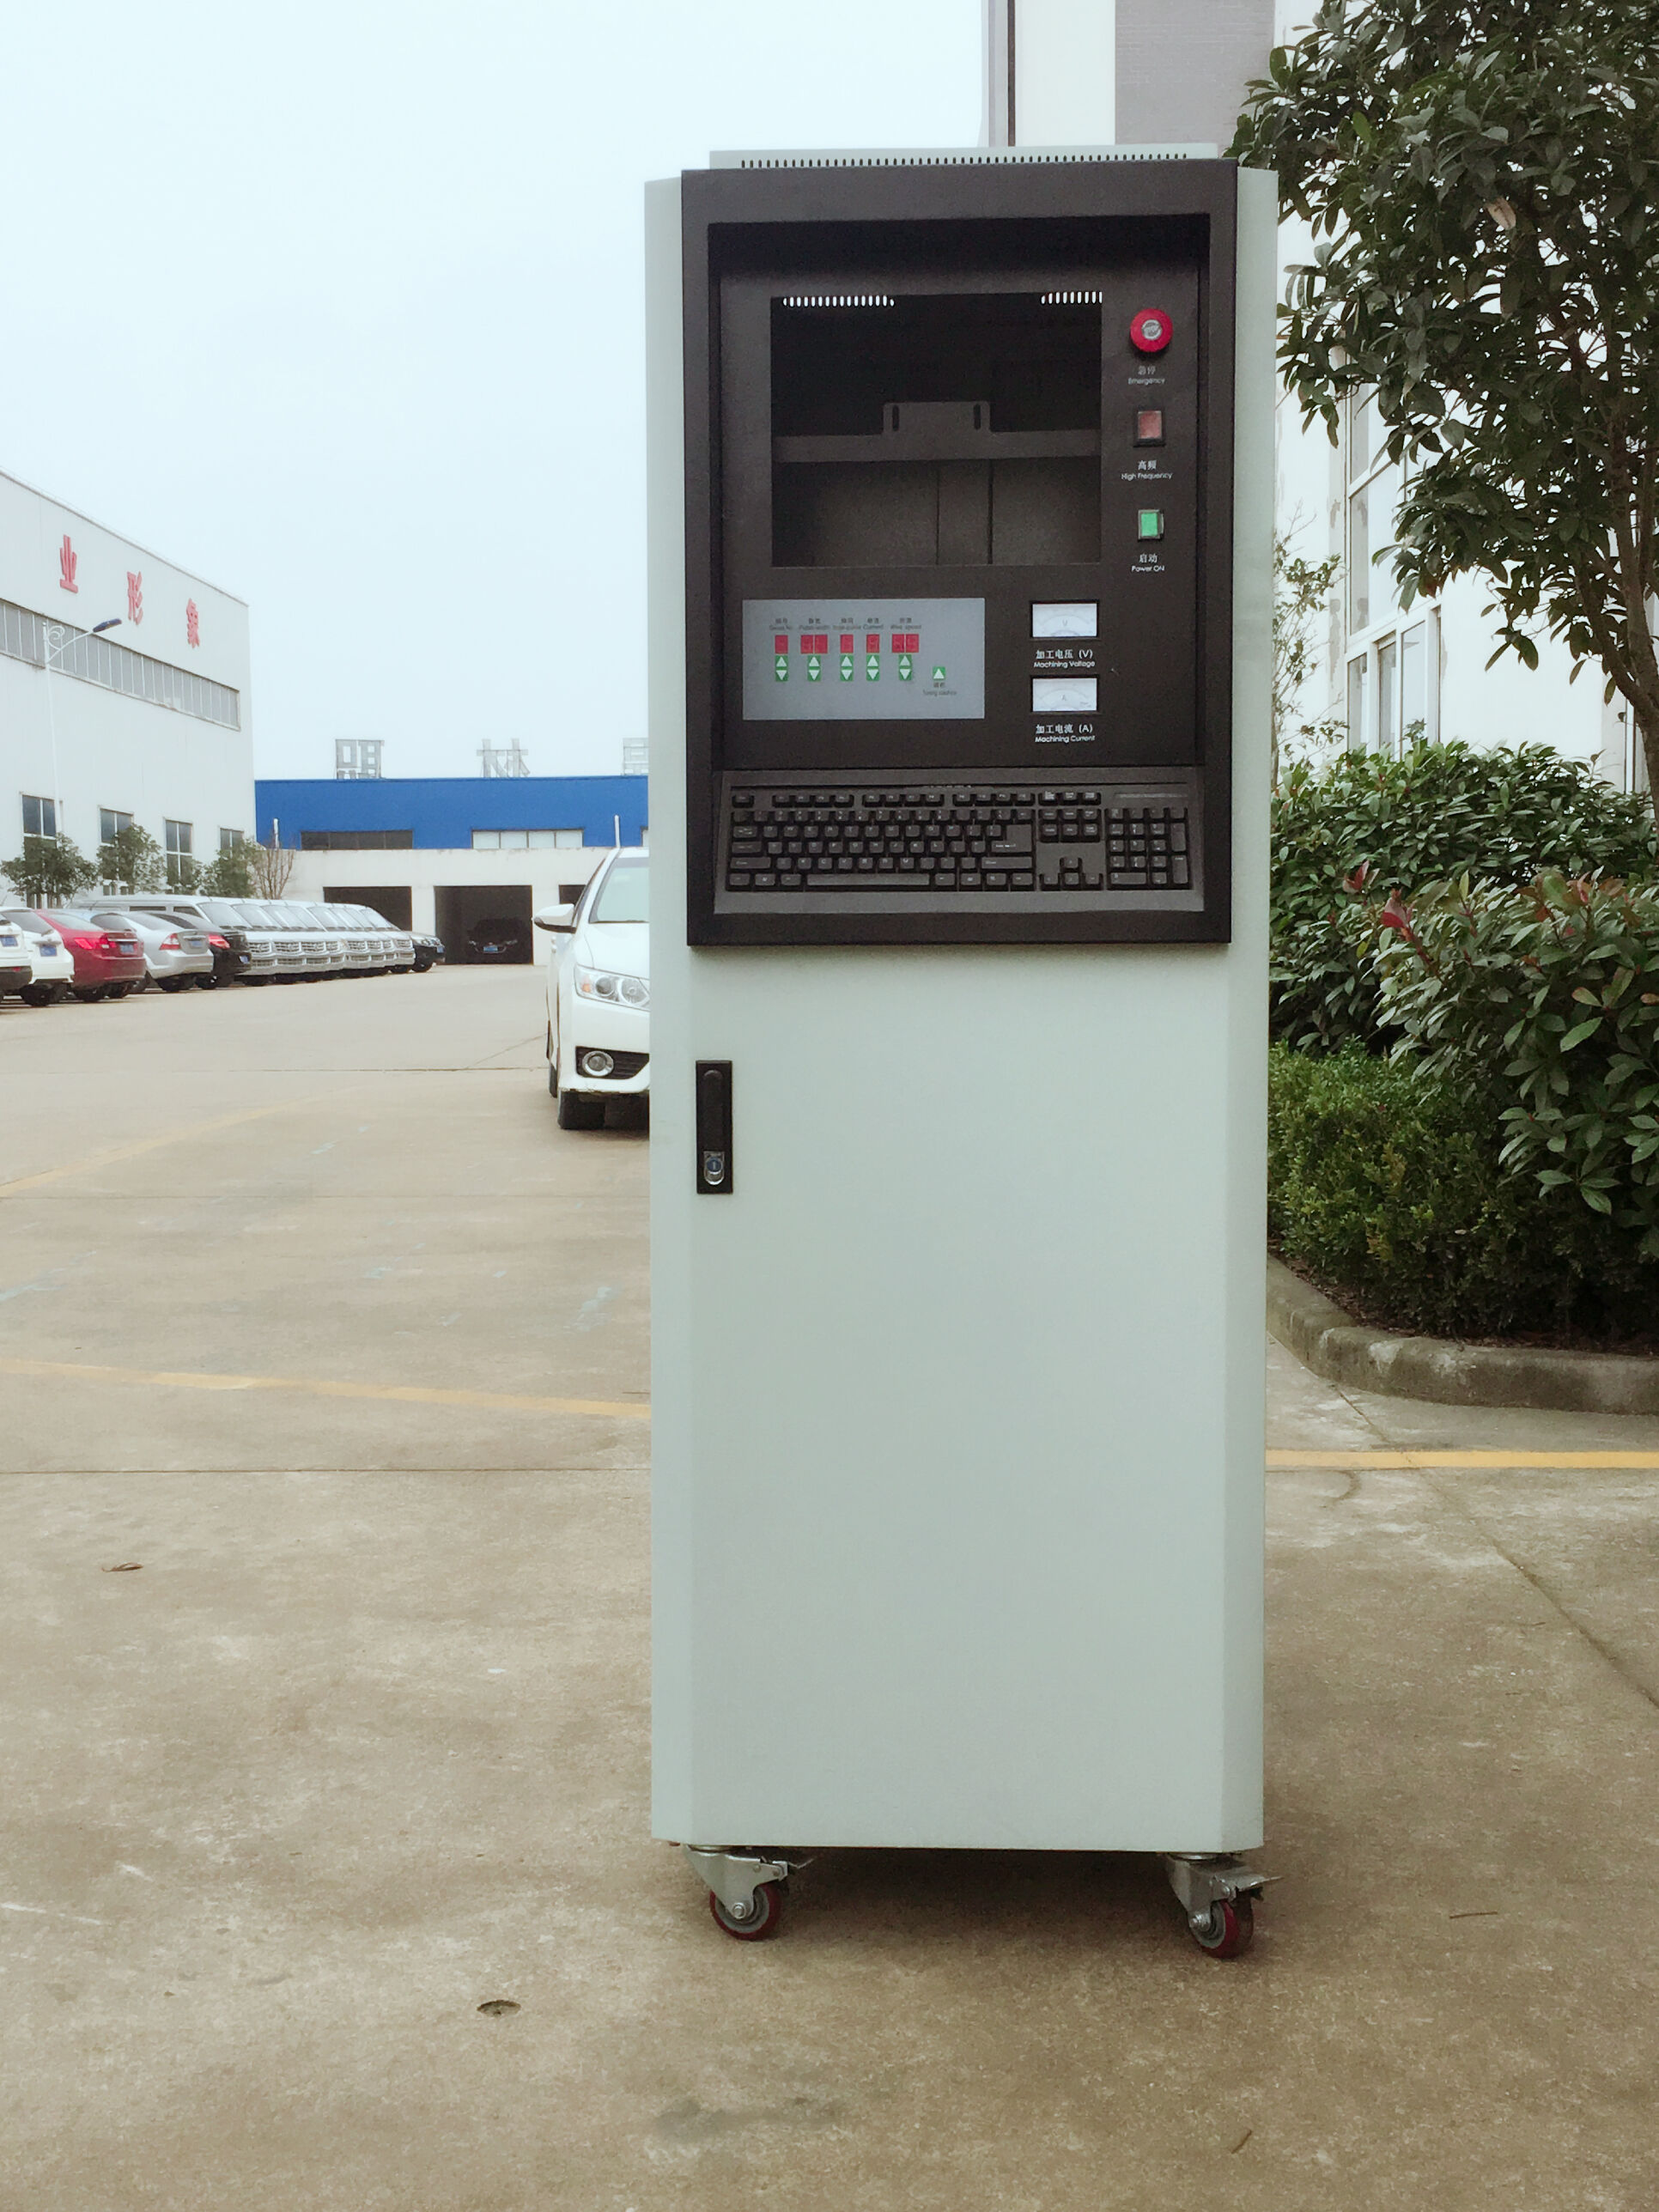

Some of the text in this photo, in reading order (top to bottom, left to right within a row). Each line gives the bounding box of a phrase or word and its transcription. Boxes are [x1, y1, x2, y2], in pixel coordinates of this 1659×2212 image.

[1139, 553, 1158, 563] 启动
[1036, 649, 1093, 659] 加工电压 (V)
[1036, 724, 1093, 734] 加工电流 (A)
